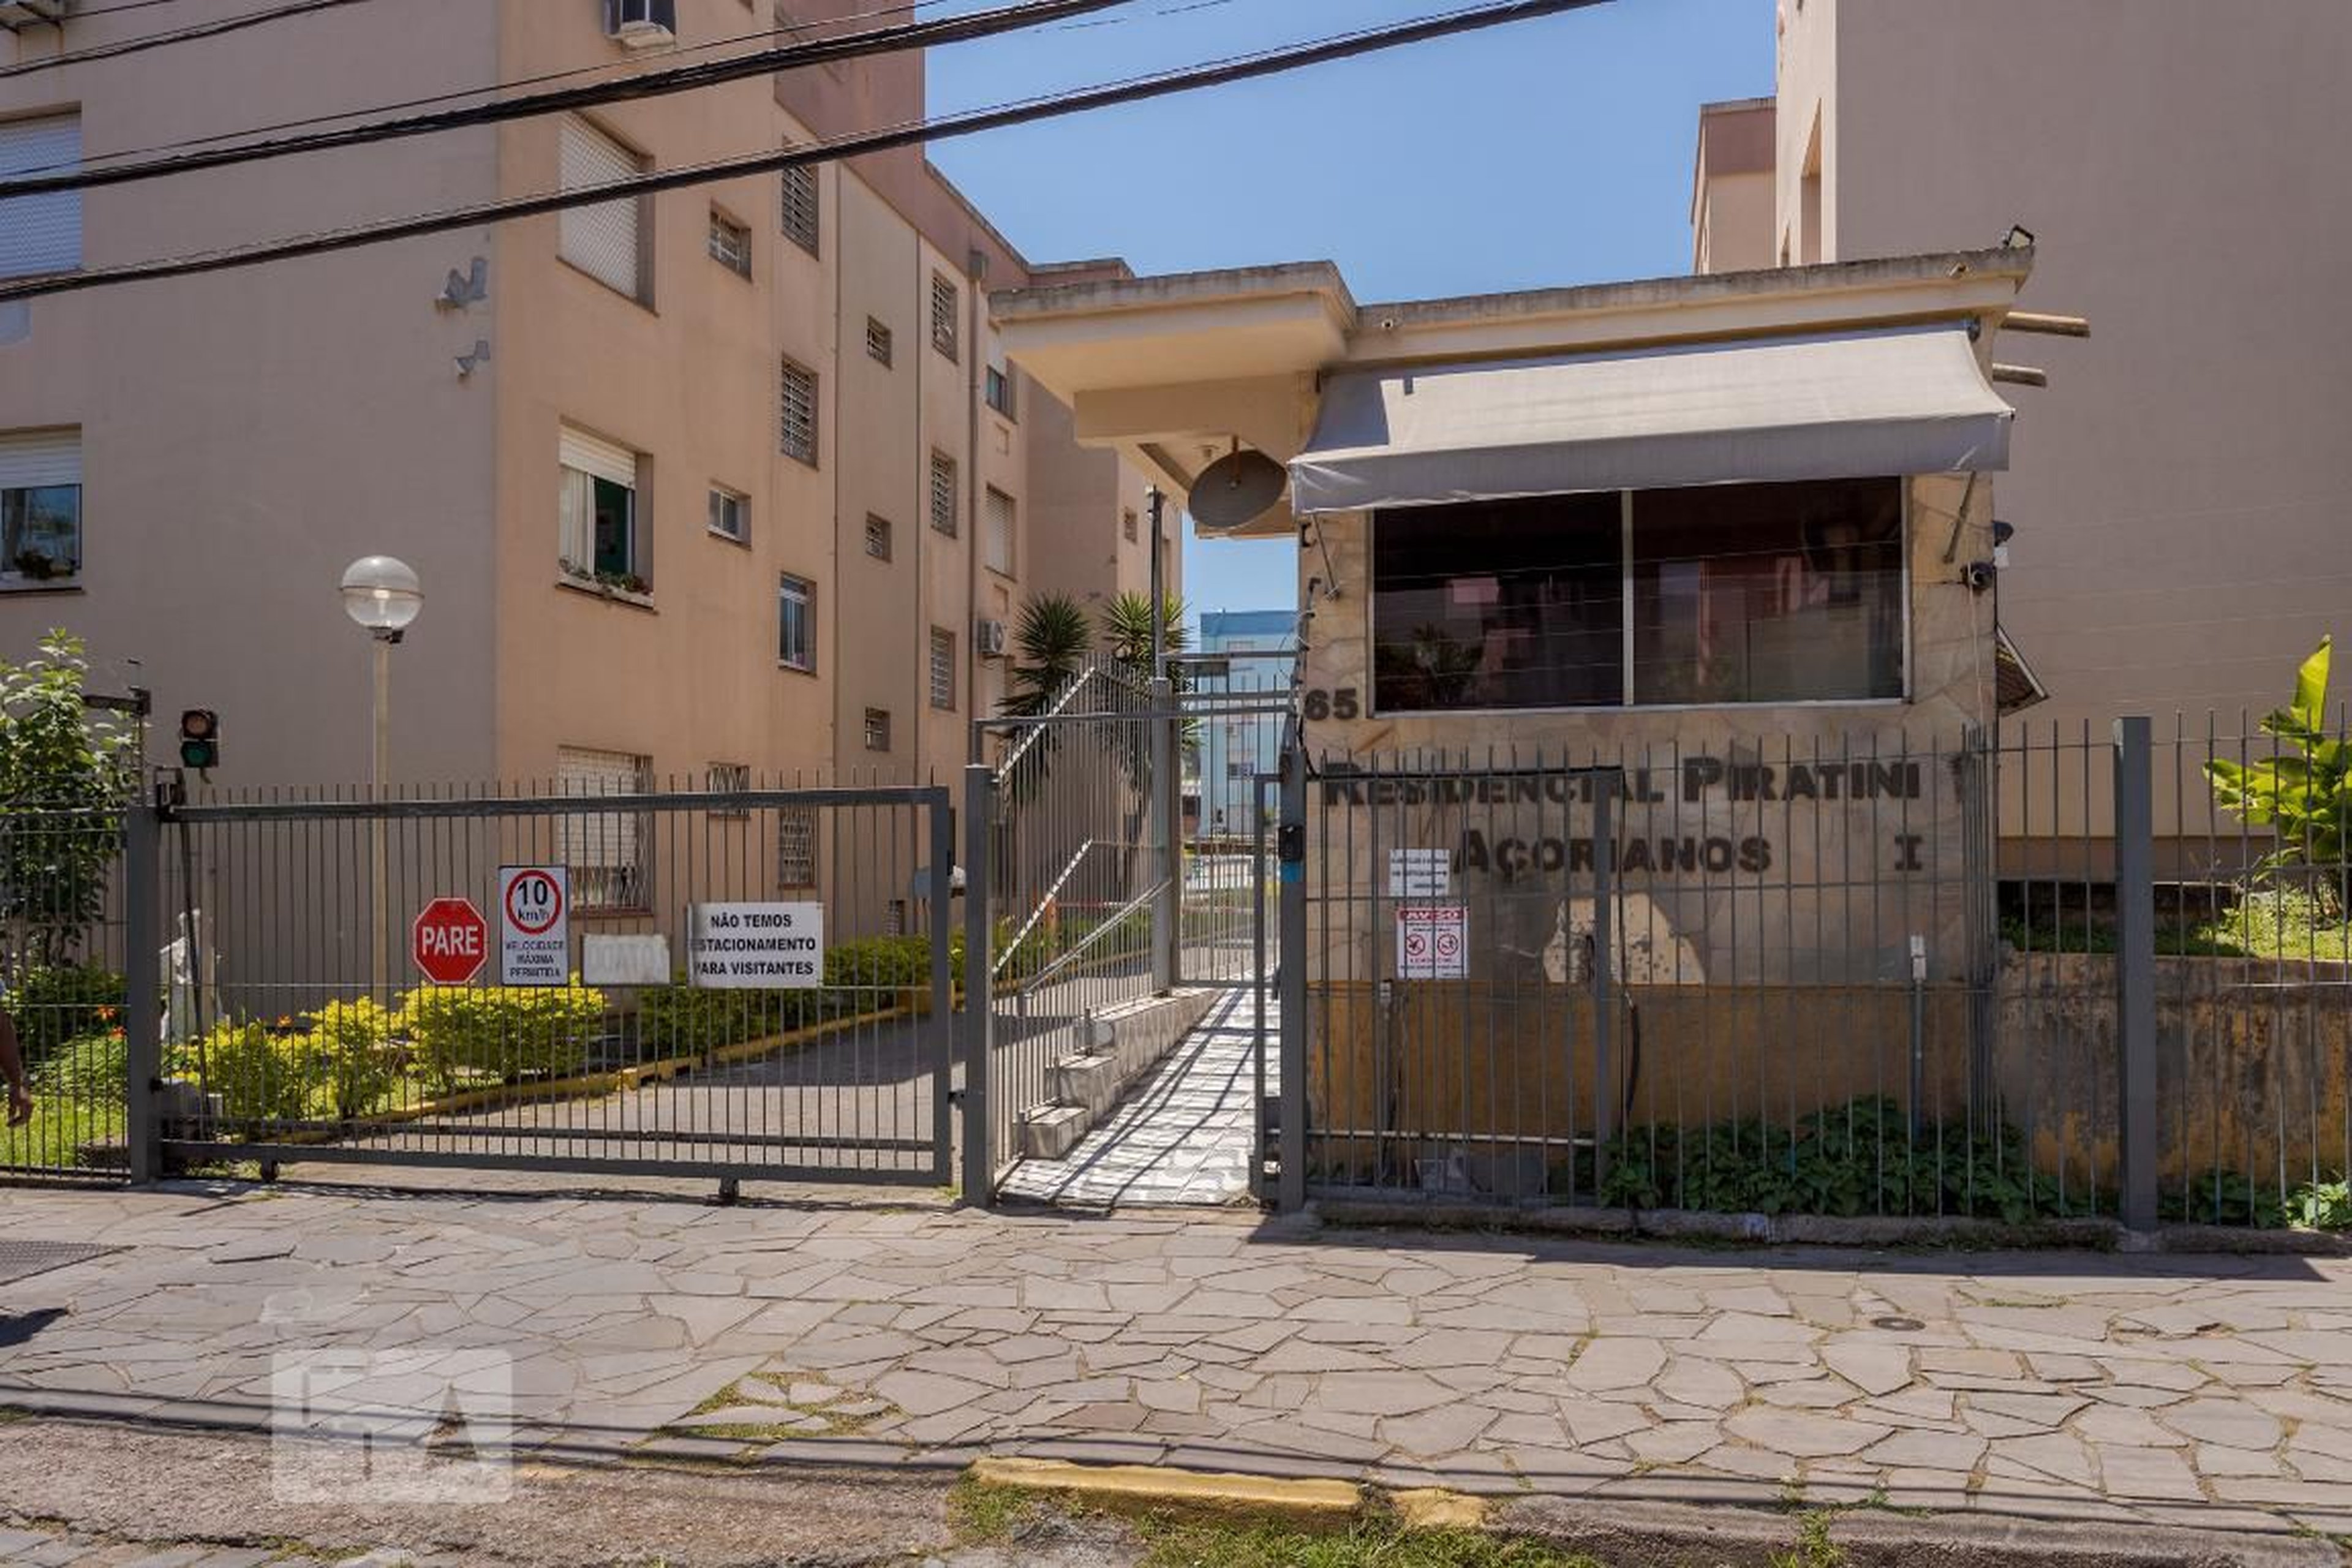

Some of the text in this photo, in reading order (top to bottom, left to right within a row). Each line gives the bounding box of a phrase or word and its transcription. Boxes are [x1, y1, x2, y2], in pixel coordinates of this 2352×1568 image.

[1304, 688, 1359, 721] 65
[1323, 756, 1920, 806] RESIDENCIAL PIRATINI
[1453, 829, 1772, 882] AÇORIANOS
[518, 880, 548, 905] 10
[710, 912, 792, 928] NÃO TEMOS
[421, 925, 479, 956] PARE
[731, 960, 814, 975] VISITANTES
